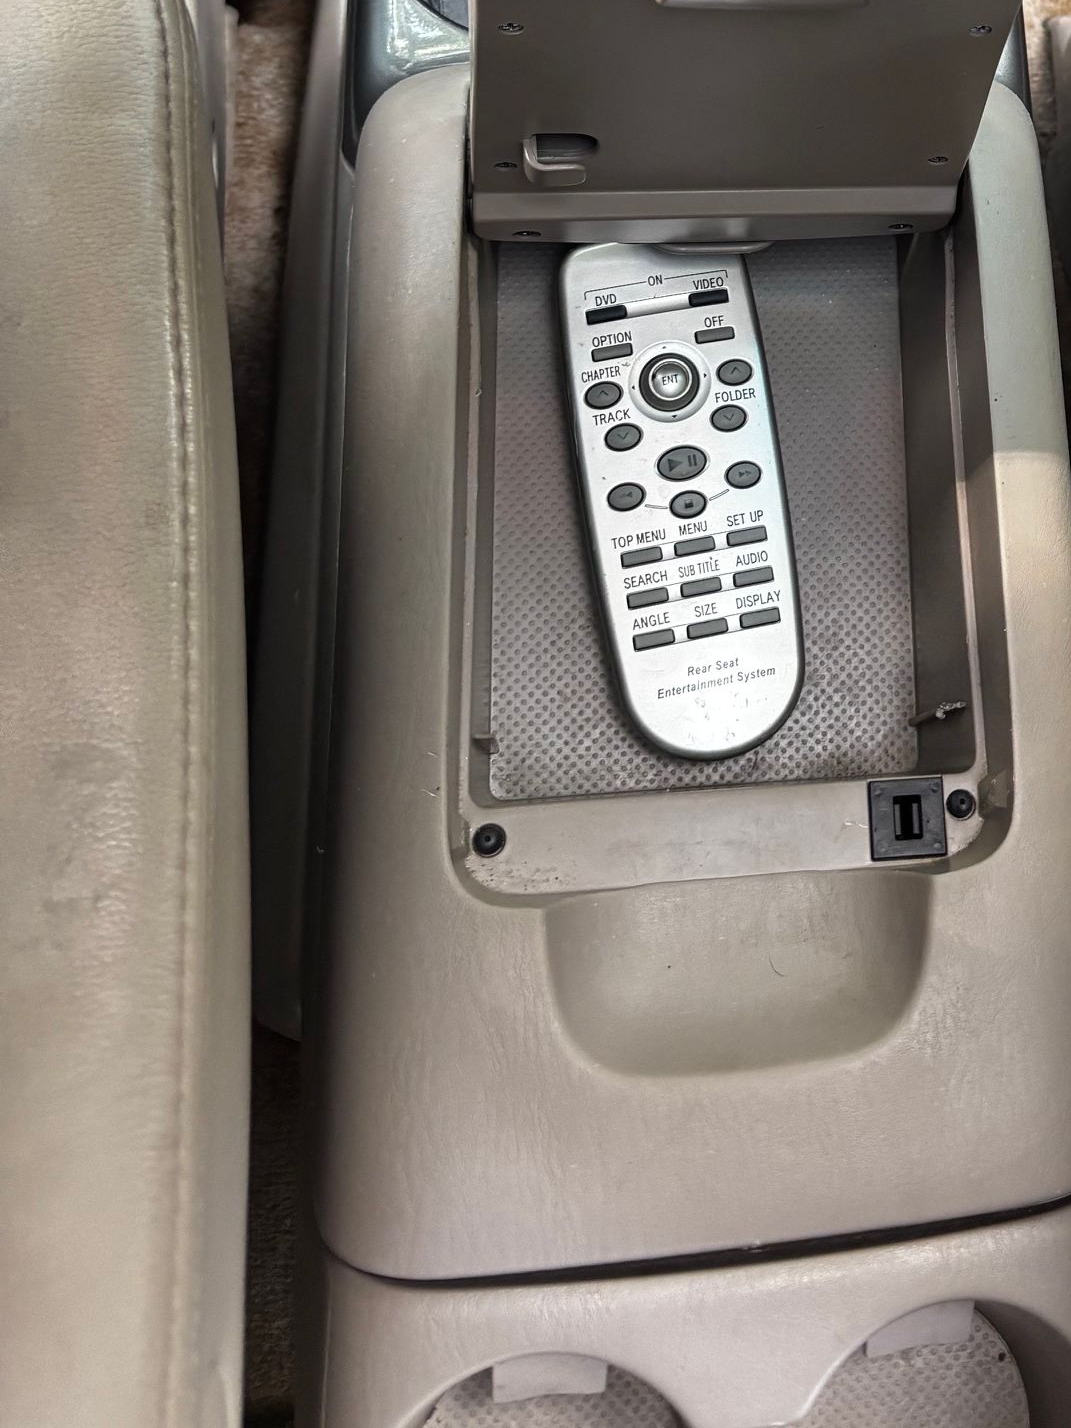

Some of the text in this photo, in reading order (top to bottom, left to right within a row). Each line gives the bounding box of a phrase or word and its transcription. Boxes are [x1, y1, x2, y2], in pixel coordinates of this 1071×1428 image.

[647, 274, 663, 286] ON
[693, 276, 724, 290] VIDEO
[595, 293, 617, 306] DVD
[704, 315, 725, 328] OFF
[592, 331, 632, 347] OPTION
[581, 366, 620, 383] CHAPTER
[661, 374, 679, 386] ENT
[715, 388, 756, 403] FOLDER
[592, 409, 631, 426] TRACK
[726, 509, 764, 527] SET UP
[678, 520, 708, 536] MENU
[611, 529, 666, 549] TOP MENU
[735, 550, 769, 567] AUDIO
[623, 570, 668, 589] SEARCH
[735, 590, 782, 610] DISPLAY
[694, 603, 718, 617] SIZE
[632, 612, 670, 630] ANGLE
[687, 657, 739, 676] Rear Seat
[657, 666, 776, 699] Entertainment System
